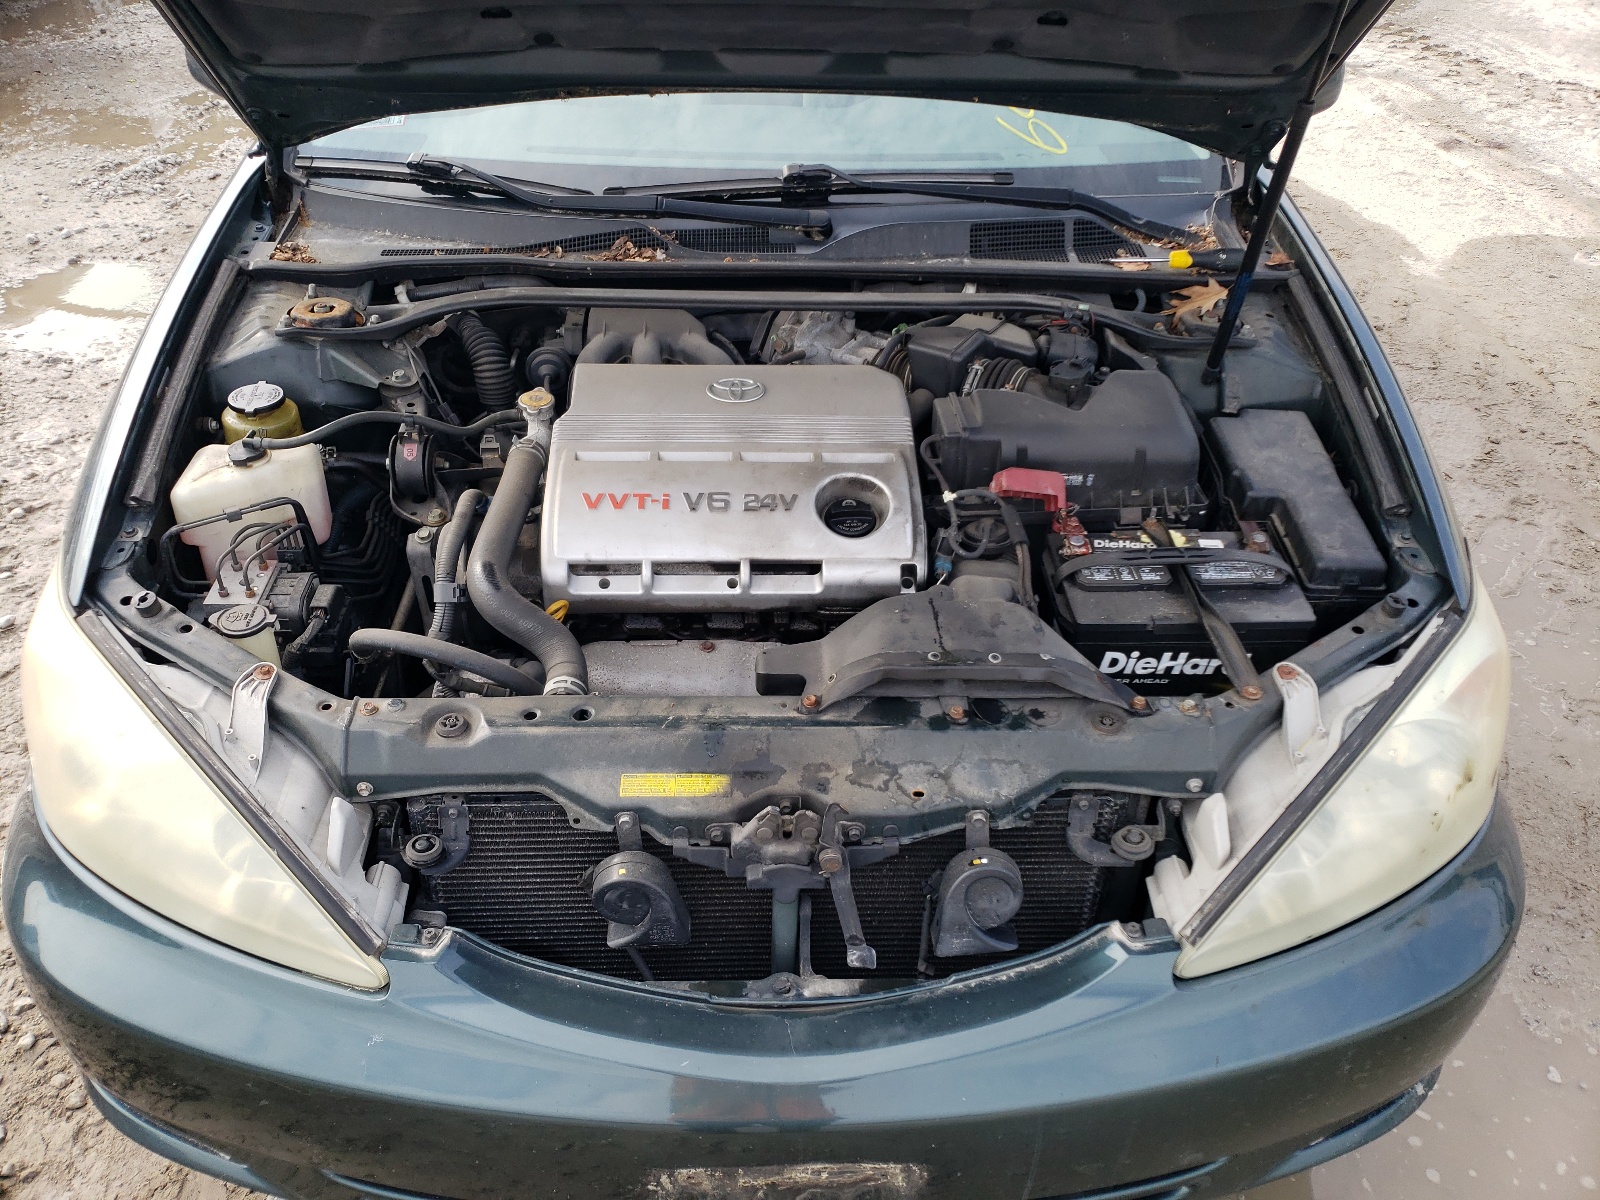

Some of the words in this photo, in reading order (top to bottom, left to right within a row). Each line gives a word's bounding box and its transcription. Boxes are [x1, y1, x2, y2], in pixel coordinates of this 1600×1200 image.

[581, 491, 671, 511] VVT-i
[681, 491, 731, 512] V6
[743, 493, 799, 512] 24V
[1099, 650, 1253, 675] DieHar
